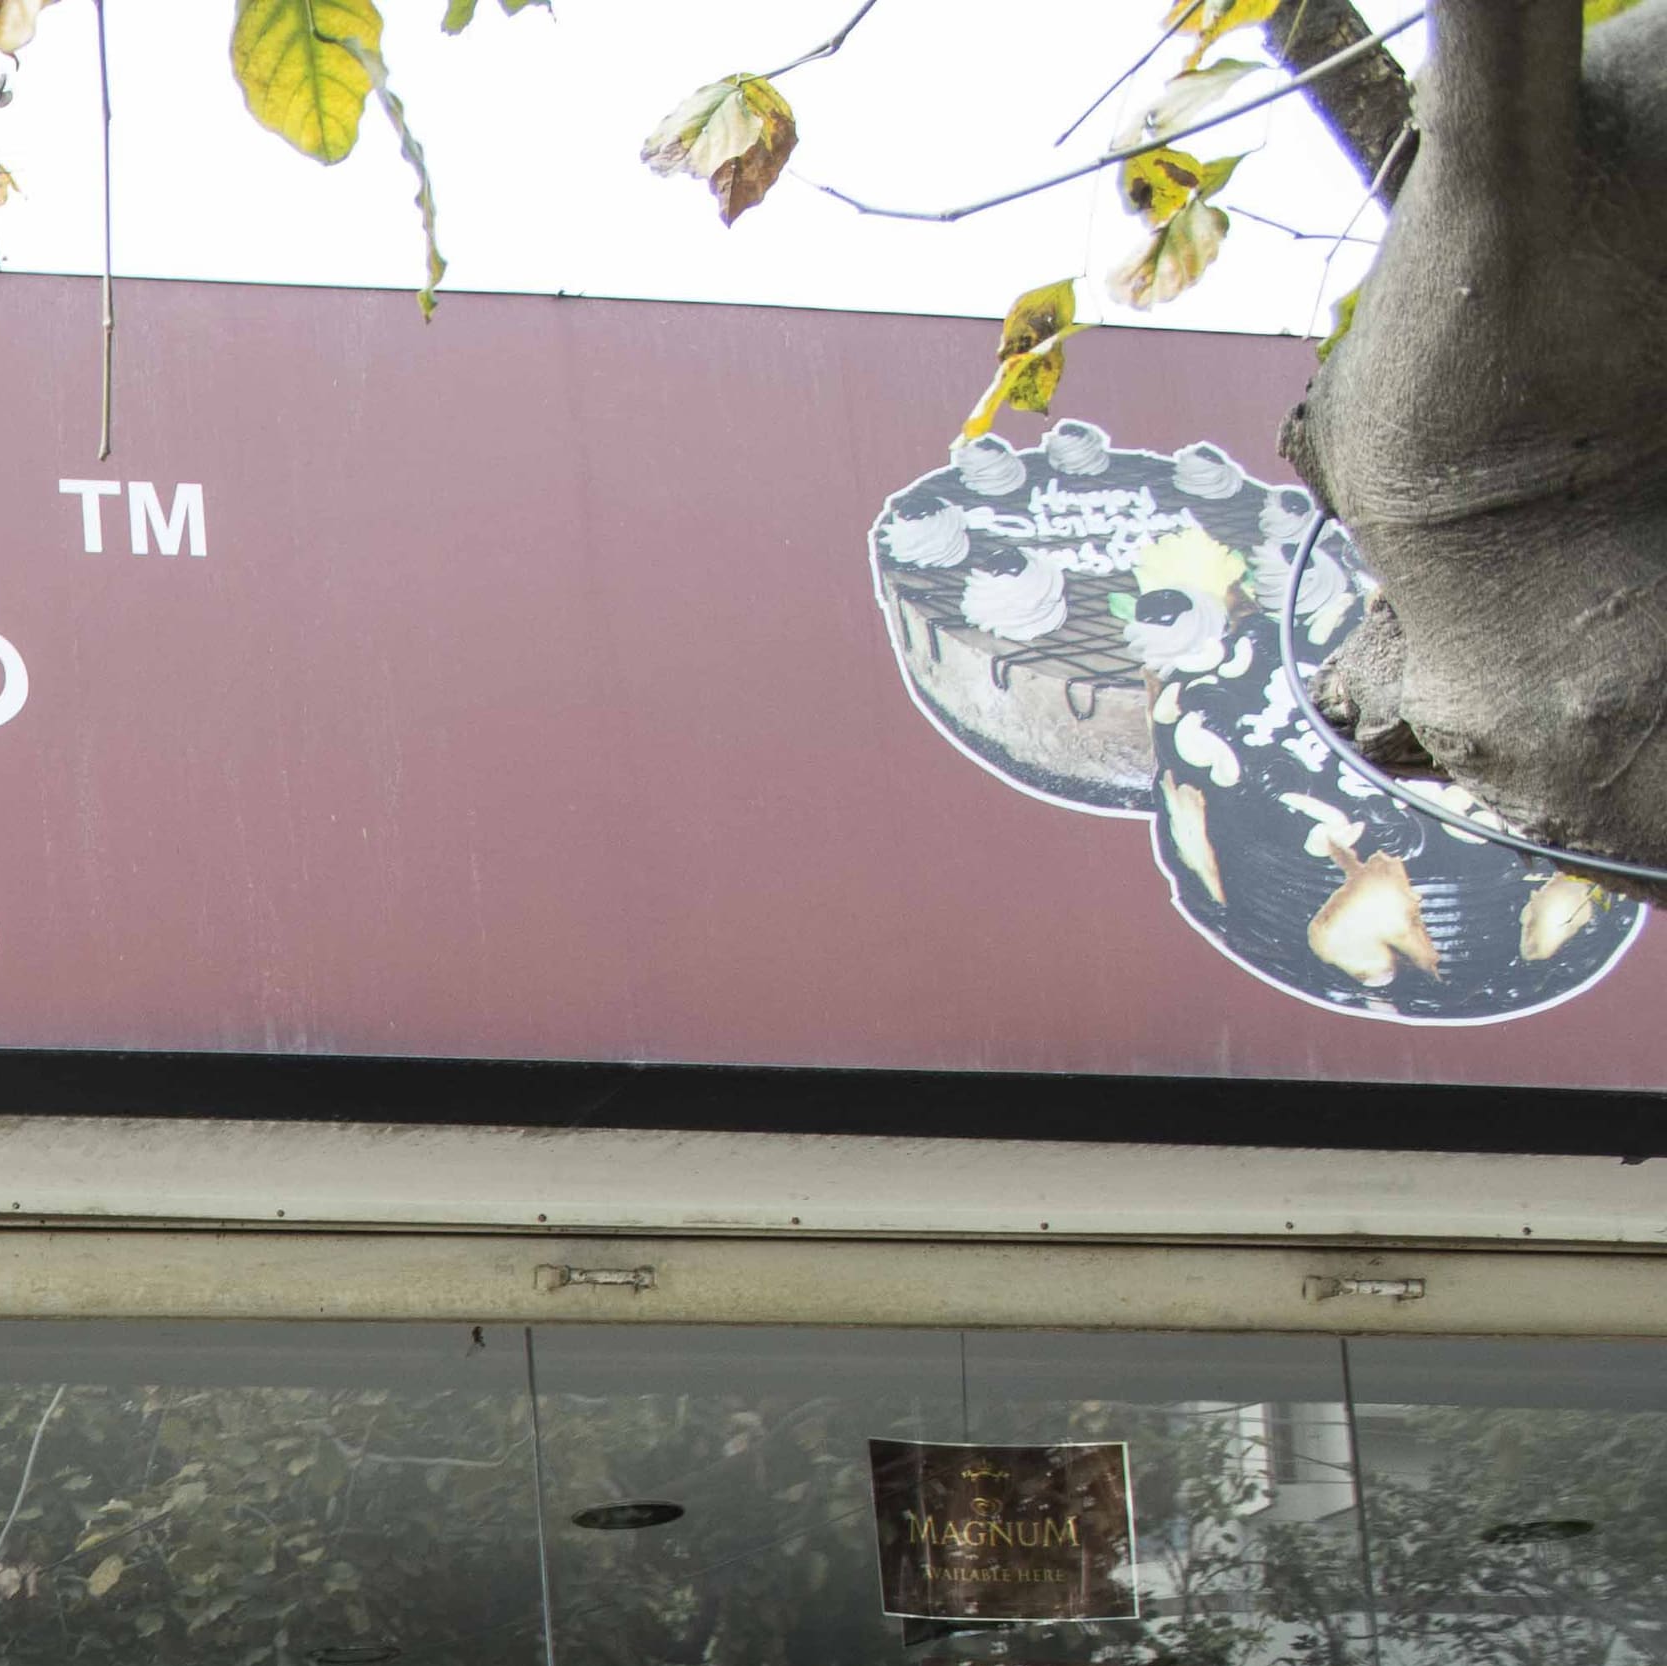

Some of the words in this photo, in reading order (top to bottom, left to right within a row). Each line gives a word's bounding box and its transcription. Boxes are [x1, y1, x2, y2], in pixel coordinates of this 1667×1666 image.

[58, 478, 207, 557] TM
[908, 1511, 1082, 1548] MAGNUM
[923, 1566, 1012, 1583] AVAILABLE
[1018, 1568, 1067, 1583] HERE
